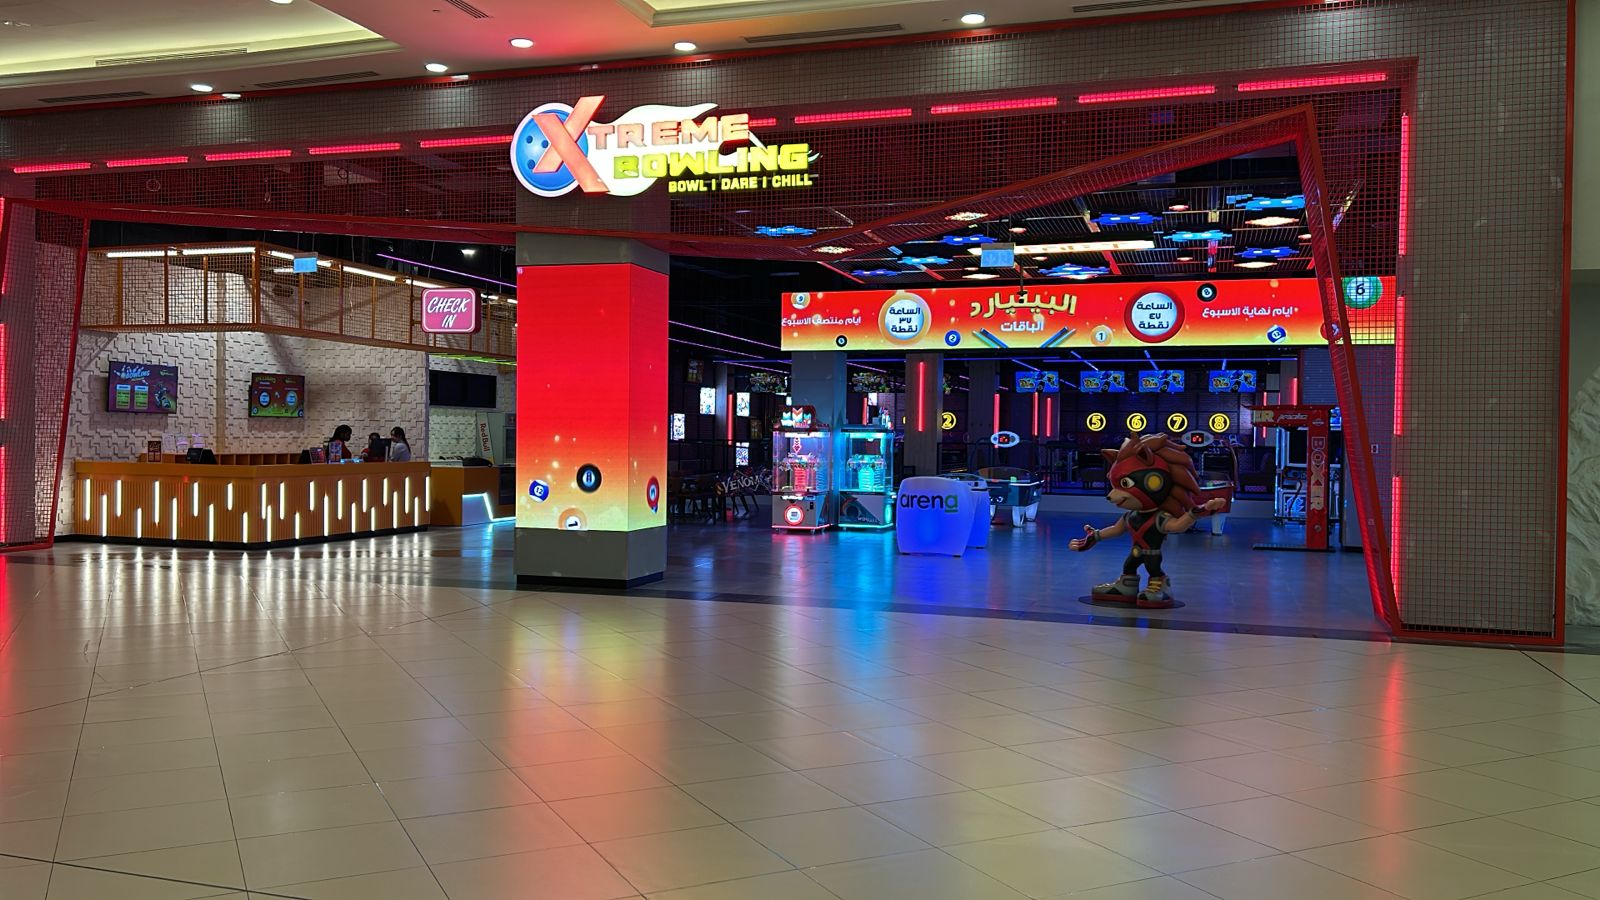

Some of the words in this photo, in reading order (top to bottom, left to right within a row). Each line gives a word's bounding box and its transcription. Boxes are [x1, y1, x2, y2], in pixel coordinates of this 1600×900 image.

[532, 95, 749, 194] XTREME
[613, 143, 809, 180] BOWLING
[668, 178, 708, 193] BOWL
[721, 176, 758, 190] DARE
[772, 174, 813, 187] CHILL
[1356, 282, 1366, 295] 6
[427, 296, 471, 314] CHECK
[889, 306, 921, 315] الساعة
[1136, 302, 1173, 310] الساعة
[1242, 306, 1271, 318] نهاية
[441, 314, 457, 328] IN
[1138, 321, 1170, 330] نقطة
[891, 325, 918, 333] نقطة
[943, 414, 952, 427] 2
[1091, 416, 1101, 429] 5
[1131, 415, 1142, 428] 6
[1173, 416, 1182, 429] 7
[1214, 416, 1224, 430] 8
[480, 423, 488, 438] Red
[482, 438, 491, 452] Bull
[900, 494, 959, 513] arena
